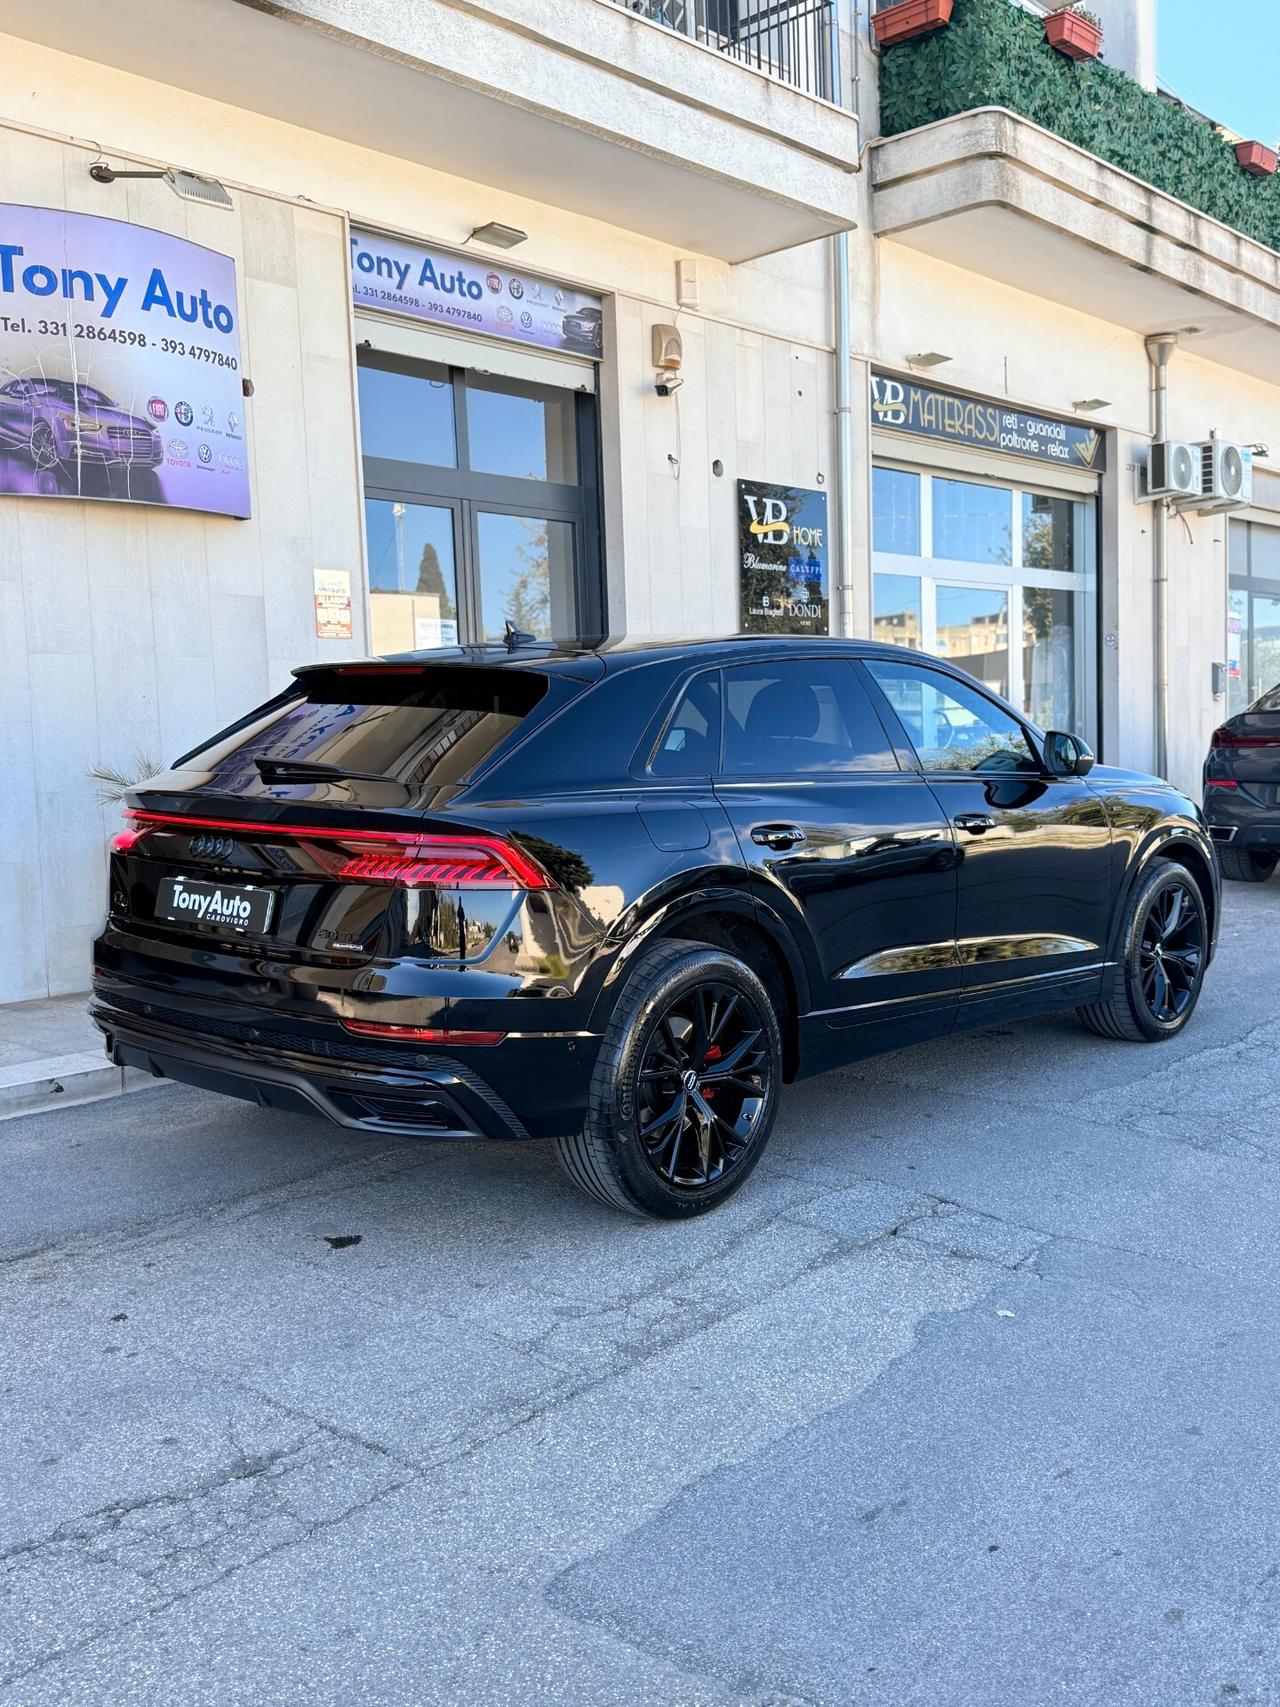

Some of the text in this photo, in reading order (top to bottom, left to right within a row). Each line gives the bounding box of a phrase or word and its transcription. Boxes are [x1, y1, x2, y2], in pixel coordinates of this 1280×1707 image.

[0, 244, 234, 334] Tony Auto
[418, 258, 483, 300] Auto
[363, 286, 378, 298] 331
[381, 290, 420, 307] 2864598
[427, 301, 444, 314] 393
[446, 307, 483, 323] 4797840
[1, 317, 32, 333] Tel.
[38, 320, 67, 336] 331
[74, 323, 147, 348] 2864598
[161, 338, 186, 356] 393
[189, 346, 238, 371] 4797840
[909, 388, 1000, 444] MATERASSI
[1002, 413, 1018, 430] reti
[1026, 421, 1066, 441] guanciali
[1000, 432, 1039, 452] poltrone
[1047, 443, 1069, 460] relax
[793, 526, 823, 548] HOME
[743, 552, 787, 572] Blumarine
[762, 596, 770, 607] B
[789, 604, 822, 618] DONDI
[172, 885, 252, 919] TonyAuto
[206, 913, 249, 927] CAROVIGNO
